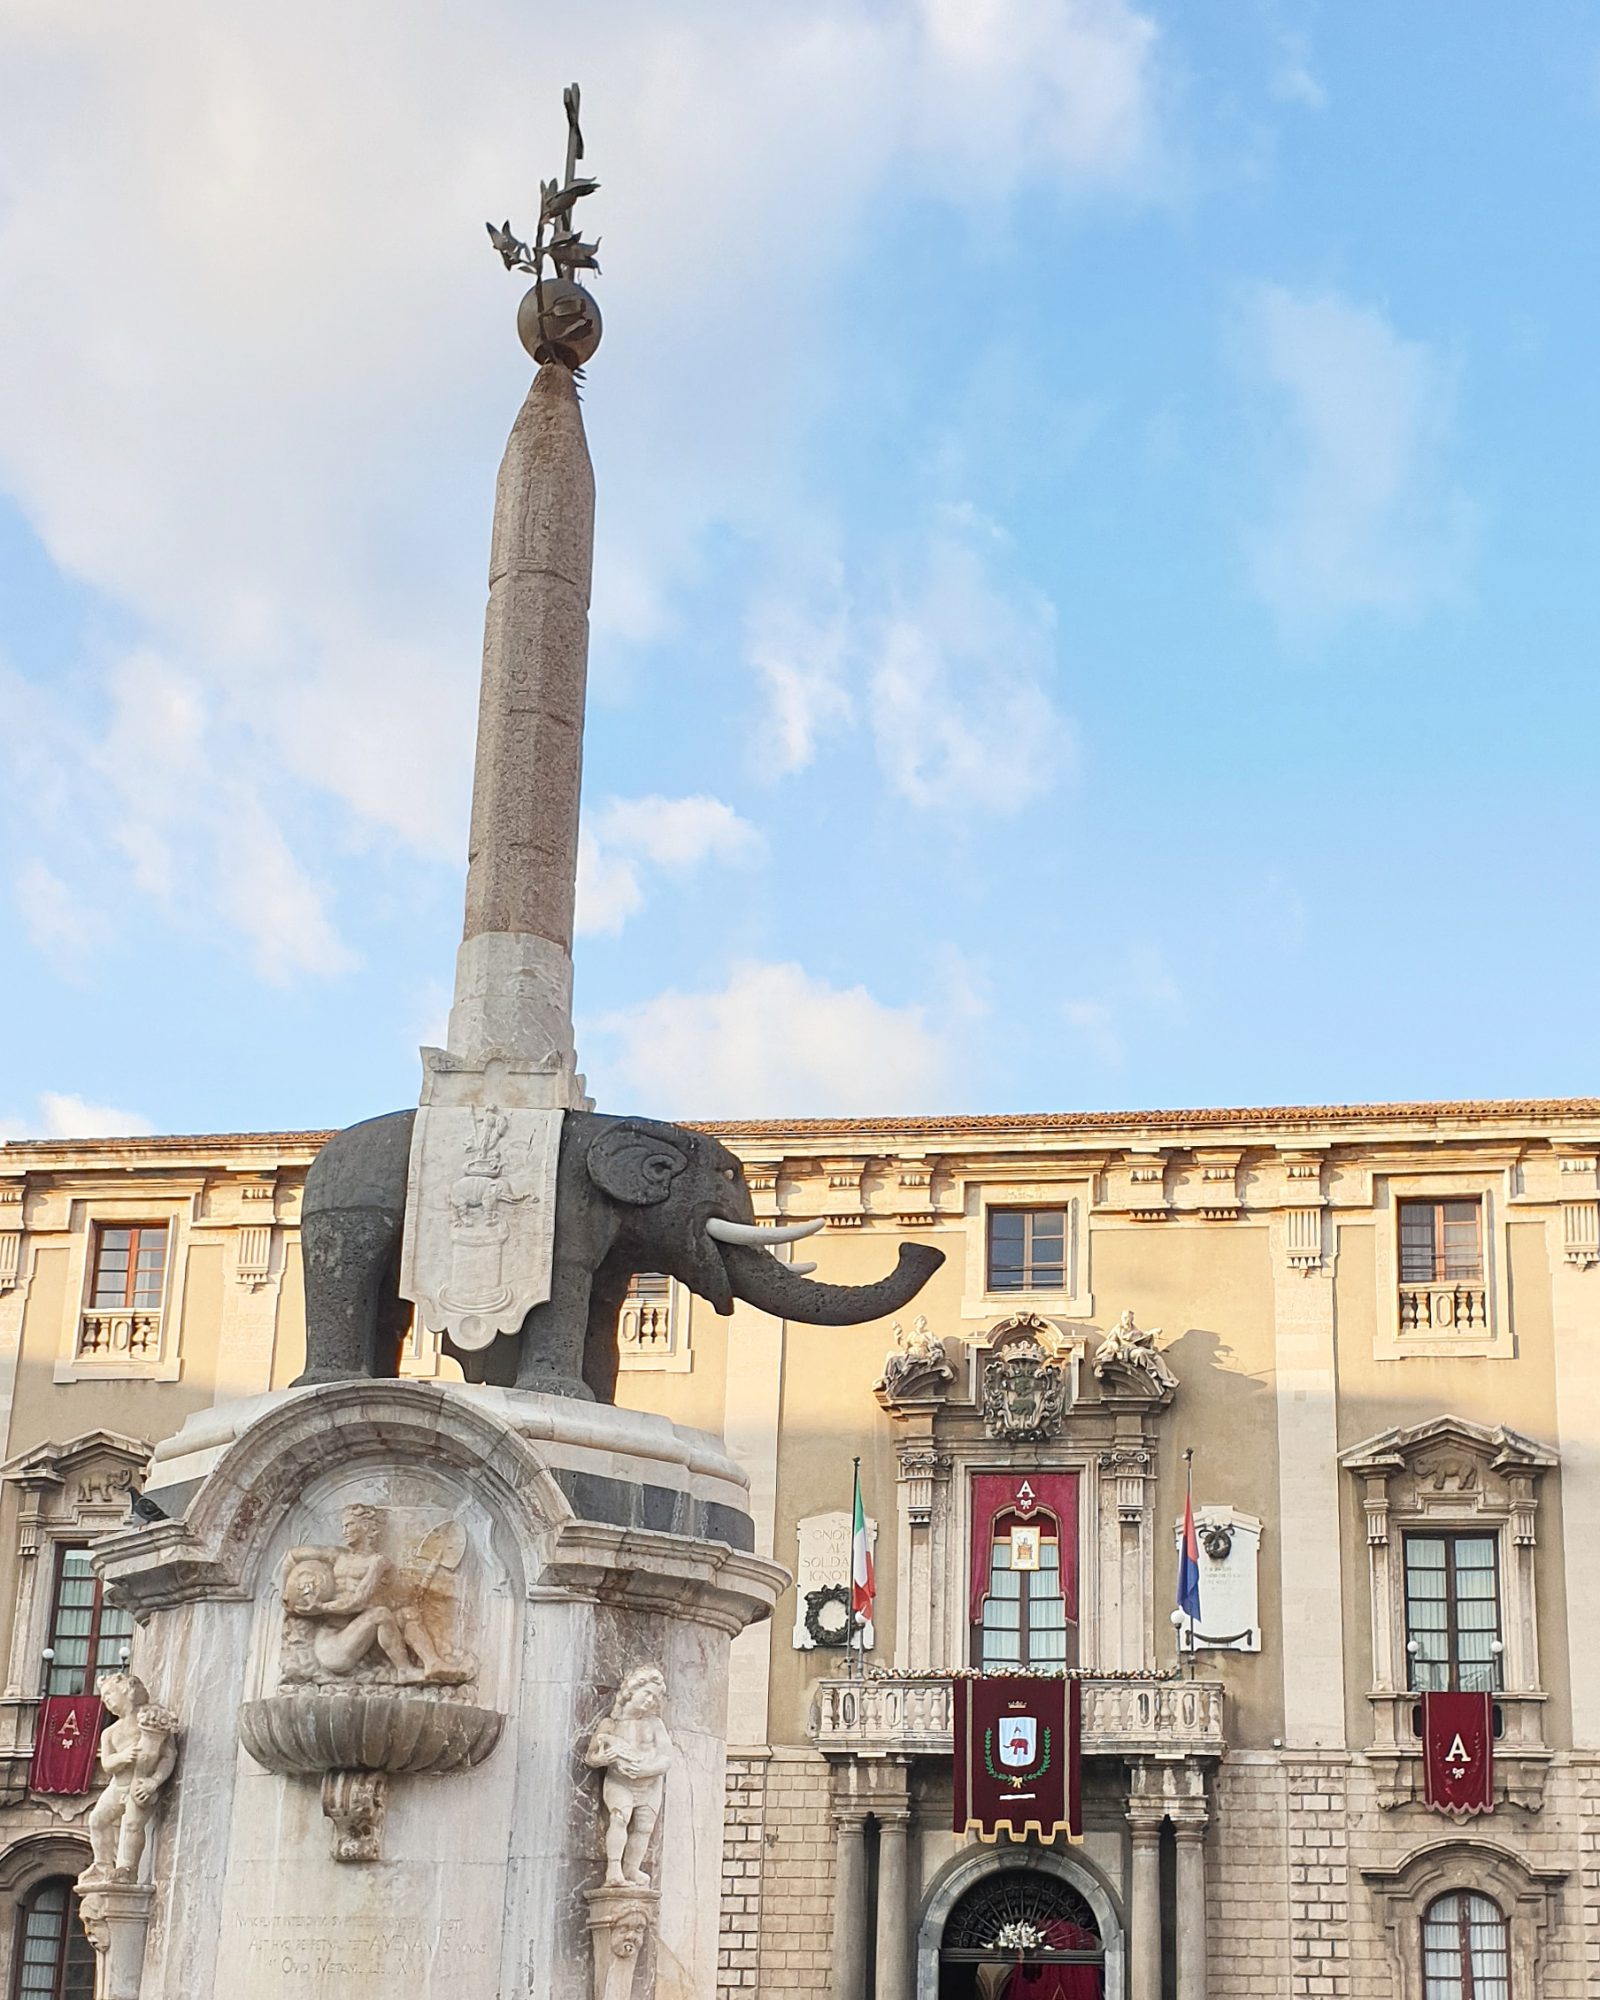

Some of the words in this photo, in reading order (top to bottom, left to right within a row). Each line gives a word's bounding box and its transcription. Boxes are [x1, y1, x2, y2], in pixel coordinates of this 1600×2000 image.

[1016, 1480, 1036, 1498] A
[801, 1556, 850, 1569] SOLDA
[57, 1709, 80, 1736] A
[1445, 1733, 1472, 1762] A
